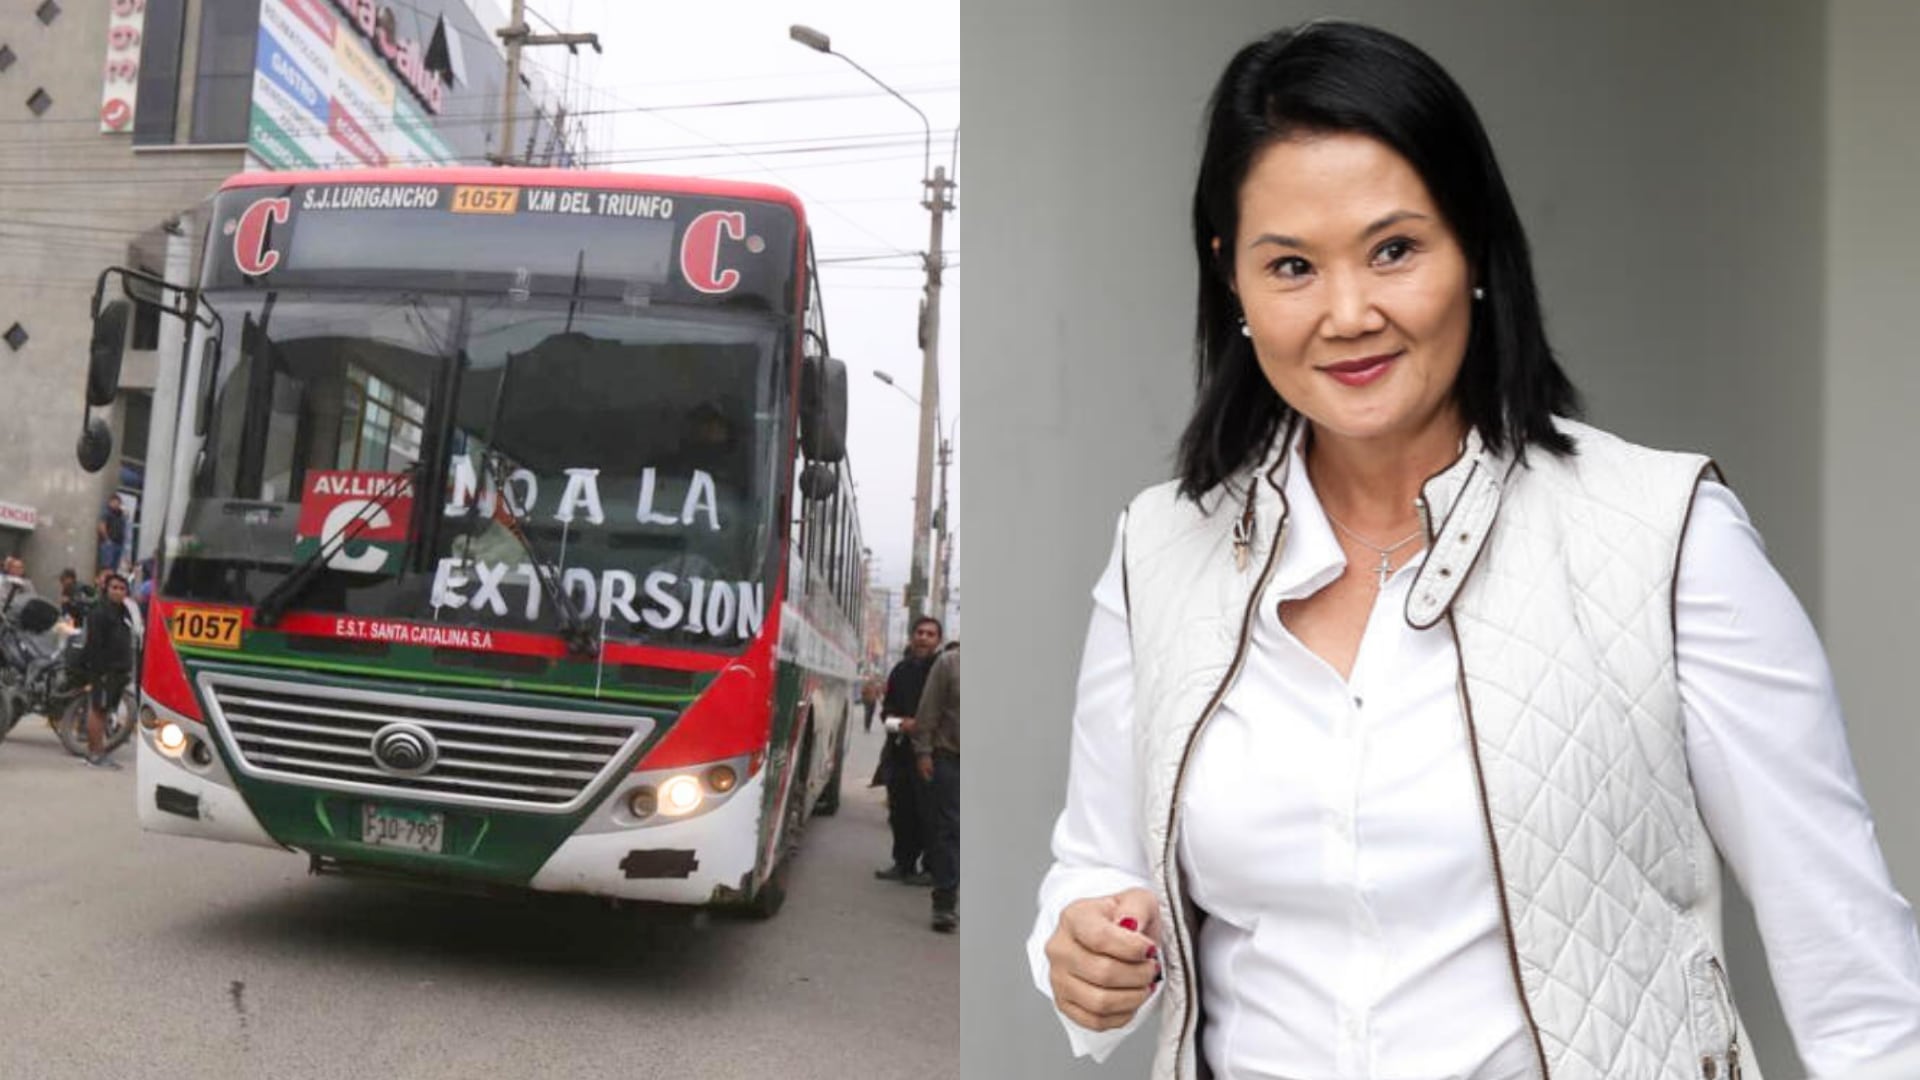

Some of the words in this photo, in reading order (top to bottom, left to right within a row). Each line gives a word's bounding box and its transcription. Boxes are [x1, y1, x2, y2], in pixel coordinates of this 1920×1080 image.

[303, 186, 439, 209] S.J.LURIGANCHO
[458, 189, 514, 208] 1057
[528, 191, 555, 211] V.M
[559, 195, 591, 213] DEL
[598, 197, 673, 219] TRIUNFO
[234, 197, 291, 276] C
[680, 210, 746, 294] C
[313, 475, 415, 498] AV.LIMA
[443, 455, 539, 520] NO
[554, 467, 605, 525] A
[636, 466, 721, 531] LA
[320, 499, 393, 573] C
[431, 556, 765, 639] EXTORSION
[174, 610, 239, 641] 1057
[336, 619, 367, 638] E.S.T.
[370, 622, 409, 641] SANTA
[411, 625, 469, 647] CATALINA
